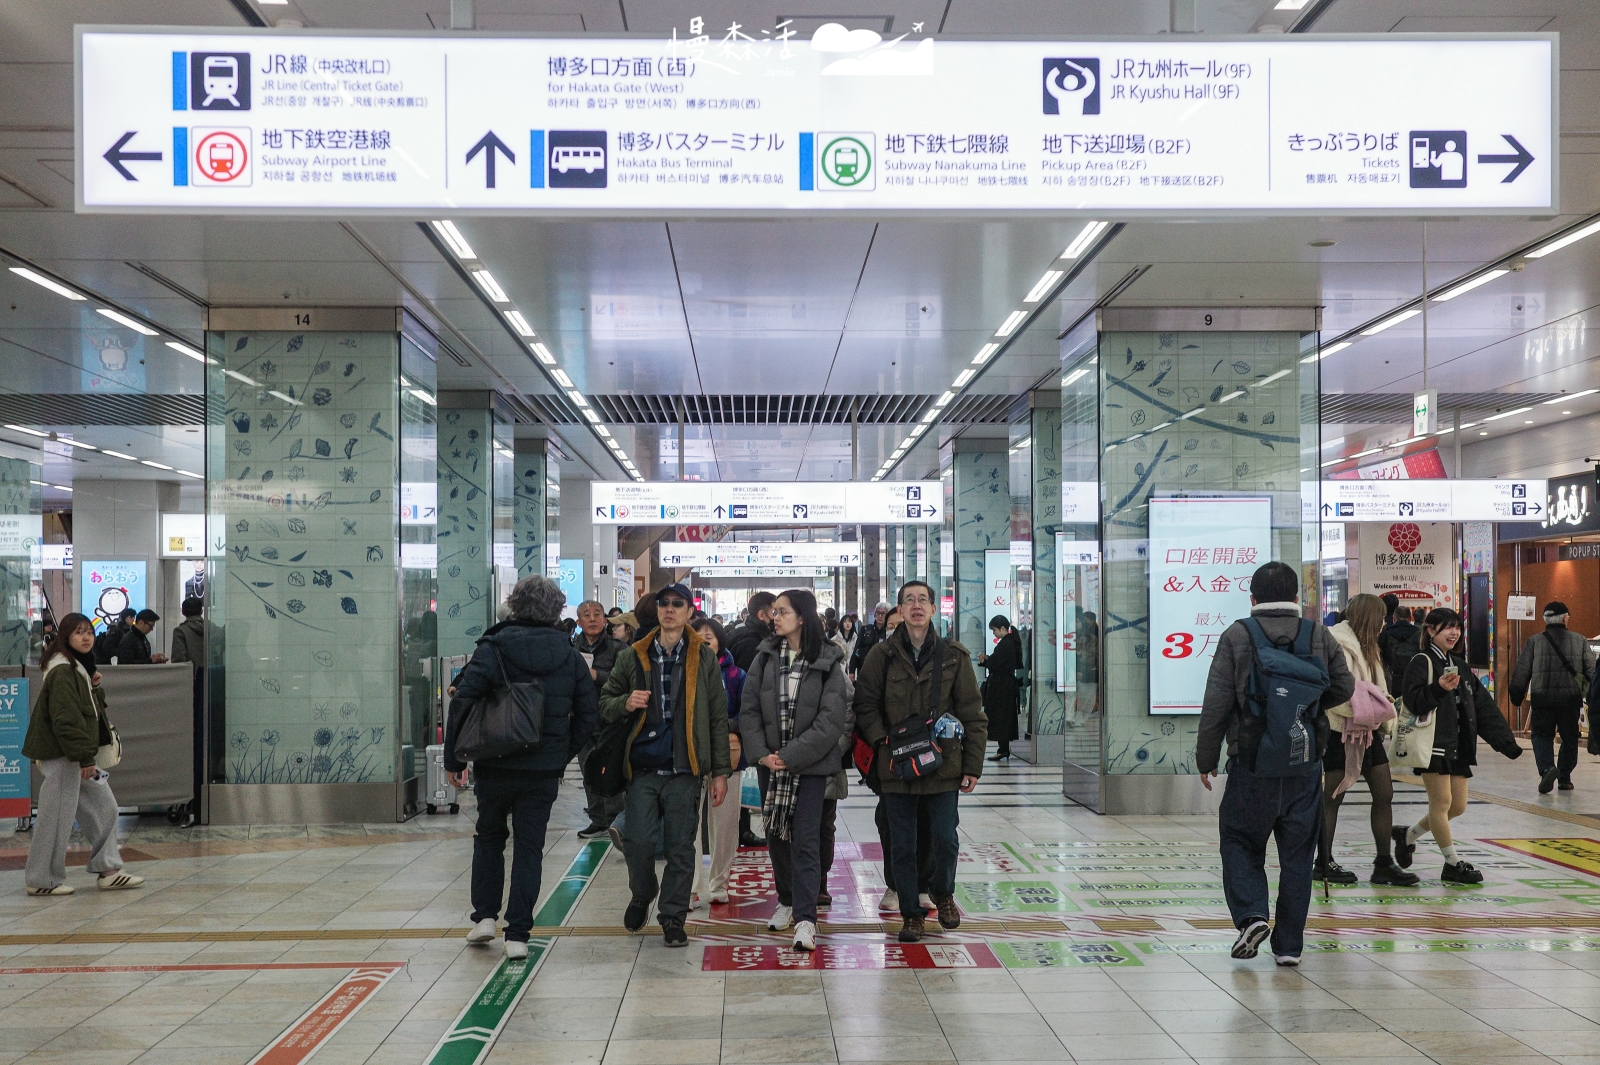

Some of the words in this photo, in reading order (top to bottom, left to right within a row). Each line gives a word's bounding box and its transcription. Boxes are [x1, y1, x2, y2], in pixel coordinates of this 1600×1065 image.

[547, 56, 696, 77] 博多口方面(西)
[1111, 59, 1251, 79] JR九州ホール(9F)
[262, 80, 275, 90] JR
[277, 81, 298, 90] Line
[343, 81, 372, 91] Ticket
[375, 82, 404, 91] Gate)
[548, 82, 563, 92] for
[569, 83, 609, 92] Hakata
[614, 84, 641, 92] Gate
[646, 83, 684, 93] (West)
[1111, 85, 1124, 99] JR
[1130, 85, 1179, 103] Kyushu
[548, 98, 579, 108] 하카타
[587, 98, 618, 108] 출입구
[262, 129, 391, 150] 地下鉄空港線
[618, 132, 784, 151] 博多バスターミナル
[885, 134, 1009, 154] 地下鉄七隈線
[1042, 134, 1191, 154] 地下送迎場(B2F)
[1288, 132, 1399, 151] きっぷうりば
[262, 156, 308, 167] Subway
[313, 156, 357, 167] Airport
[362, 156, 386, 166] Line
[618, 158, 656, 167] Hakata
[661, 158, 680, 167] Bus
[685, 158, 733, 167] Terminal
[885, 160, 931, 171] Subway
[935, 160, 997, 170] Nanakuma
[1002, 160, 1026, 169] Line
[1042, 160, 1080, 171] Pickup
[1086, 161, 1113, 169] Area
[1117, 160, 1147, 169] (B2F)
[1362, 158, 1399, 167] Tickets
[263, 171, 295, 181] 지하철
[301, 171, 333, 181] 공항선
[342, 172, 397, 181] 地铁机场线
[618, 174, 649, 183] 하카타
[656, 174, 710, 183] 버스터미널
[719, 174, 783, 183] 博多汽车总站
[885, 176, 914, 185] 지하철
[1043, 176, 1062, 185] 지하
[1348, 174, 1400, 183] 자동매표기
[294, 314, 310, 325] 14
[1205, 314, 1212, 326] 9
[177, 537, 183, 545] 4
[1165, 547, 1258, 565] 口座開設
[1569, 546, 1590, 558] POPUP
[1375, 553, 1435, 565] 博多銘品蔵
[1194, 612, 1227, 626] 最大
[1069, 944, 1127, 964] 現金
